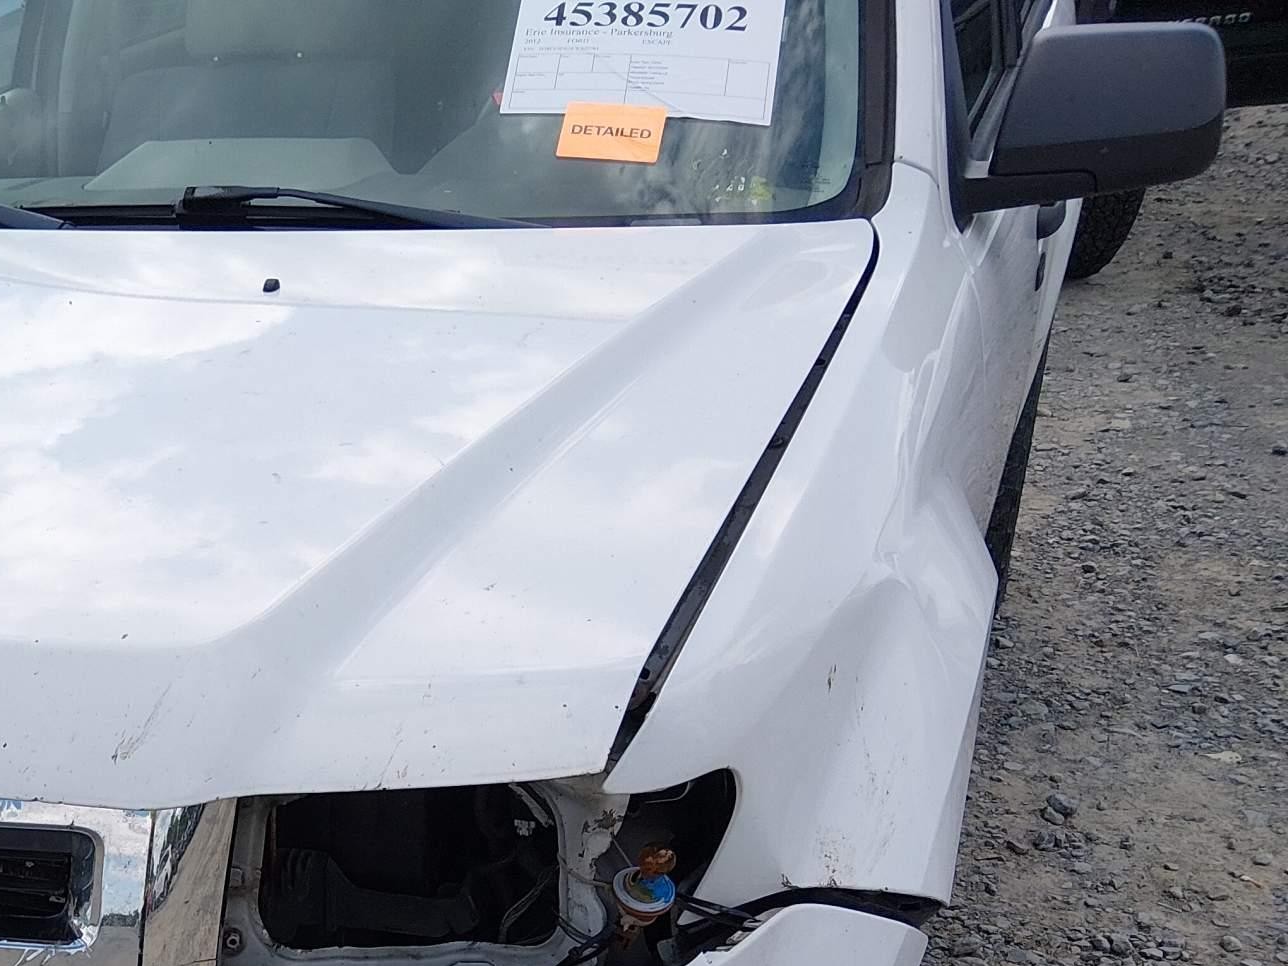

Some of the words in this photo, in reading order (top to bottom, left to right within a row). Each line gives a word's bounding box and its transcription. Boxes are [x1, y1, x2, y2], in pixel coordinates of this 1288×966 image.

[544, 2, 748, 31] 45385702
[550, 28, 600, 37] Insurance
[610, 28, 673, 38] Parkersburg
[571, 123, 652, 140] DETAILED
